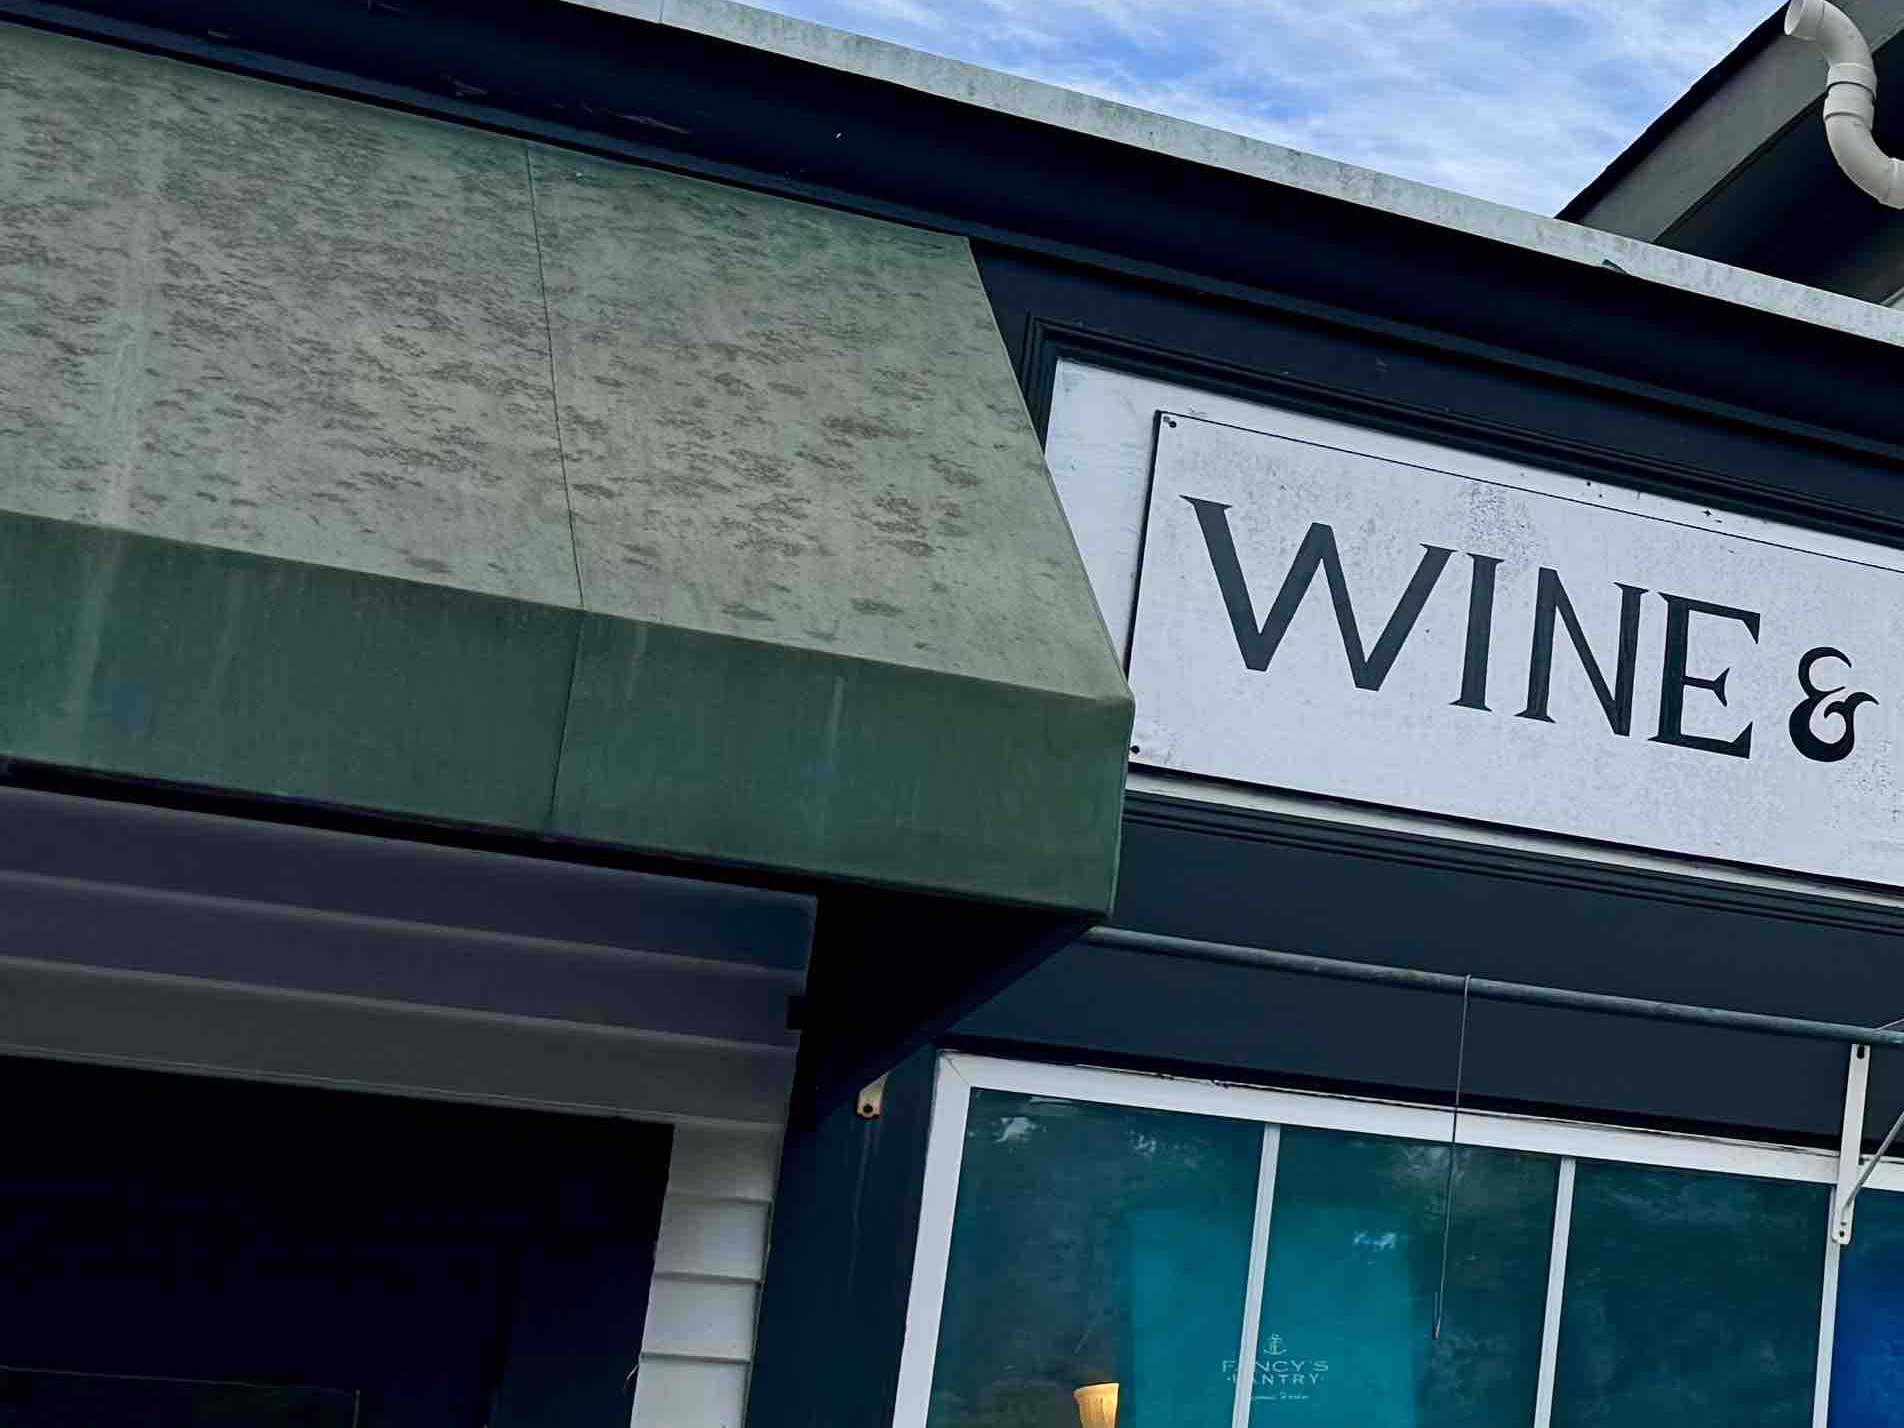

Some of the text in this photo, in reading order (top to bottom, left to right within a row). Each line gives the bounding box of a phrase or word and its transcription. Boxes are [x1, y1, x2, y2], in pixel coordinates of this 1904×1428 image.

[1180, 494, 1761, 759] WINE
[1787, 645, 1878, 762] &
[1222, 1360, 1329, 1373] FNCY'S
